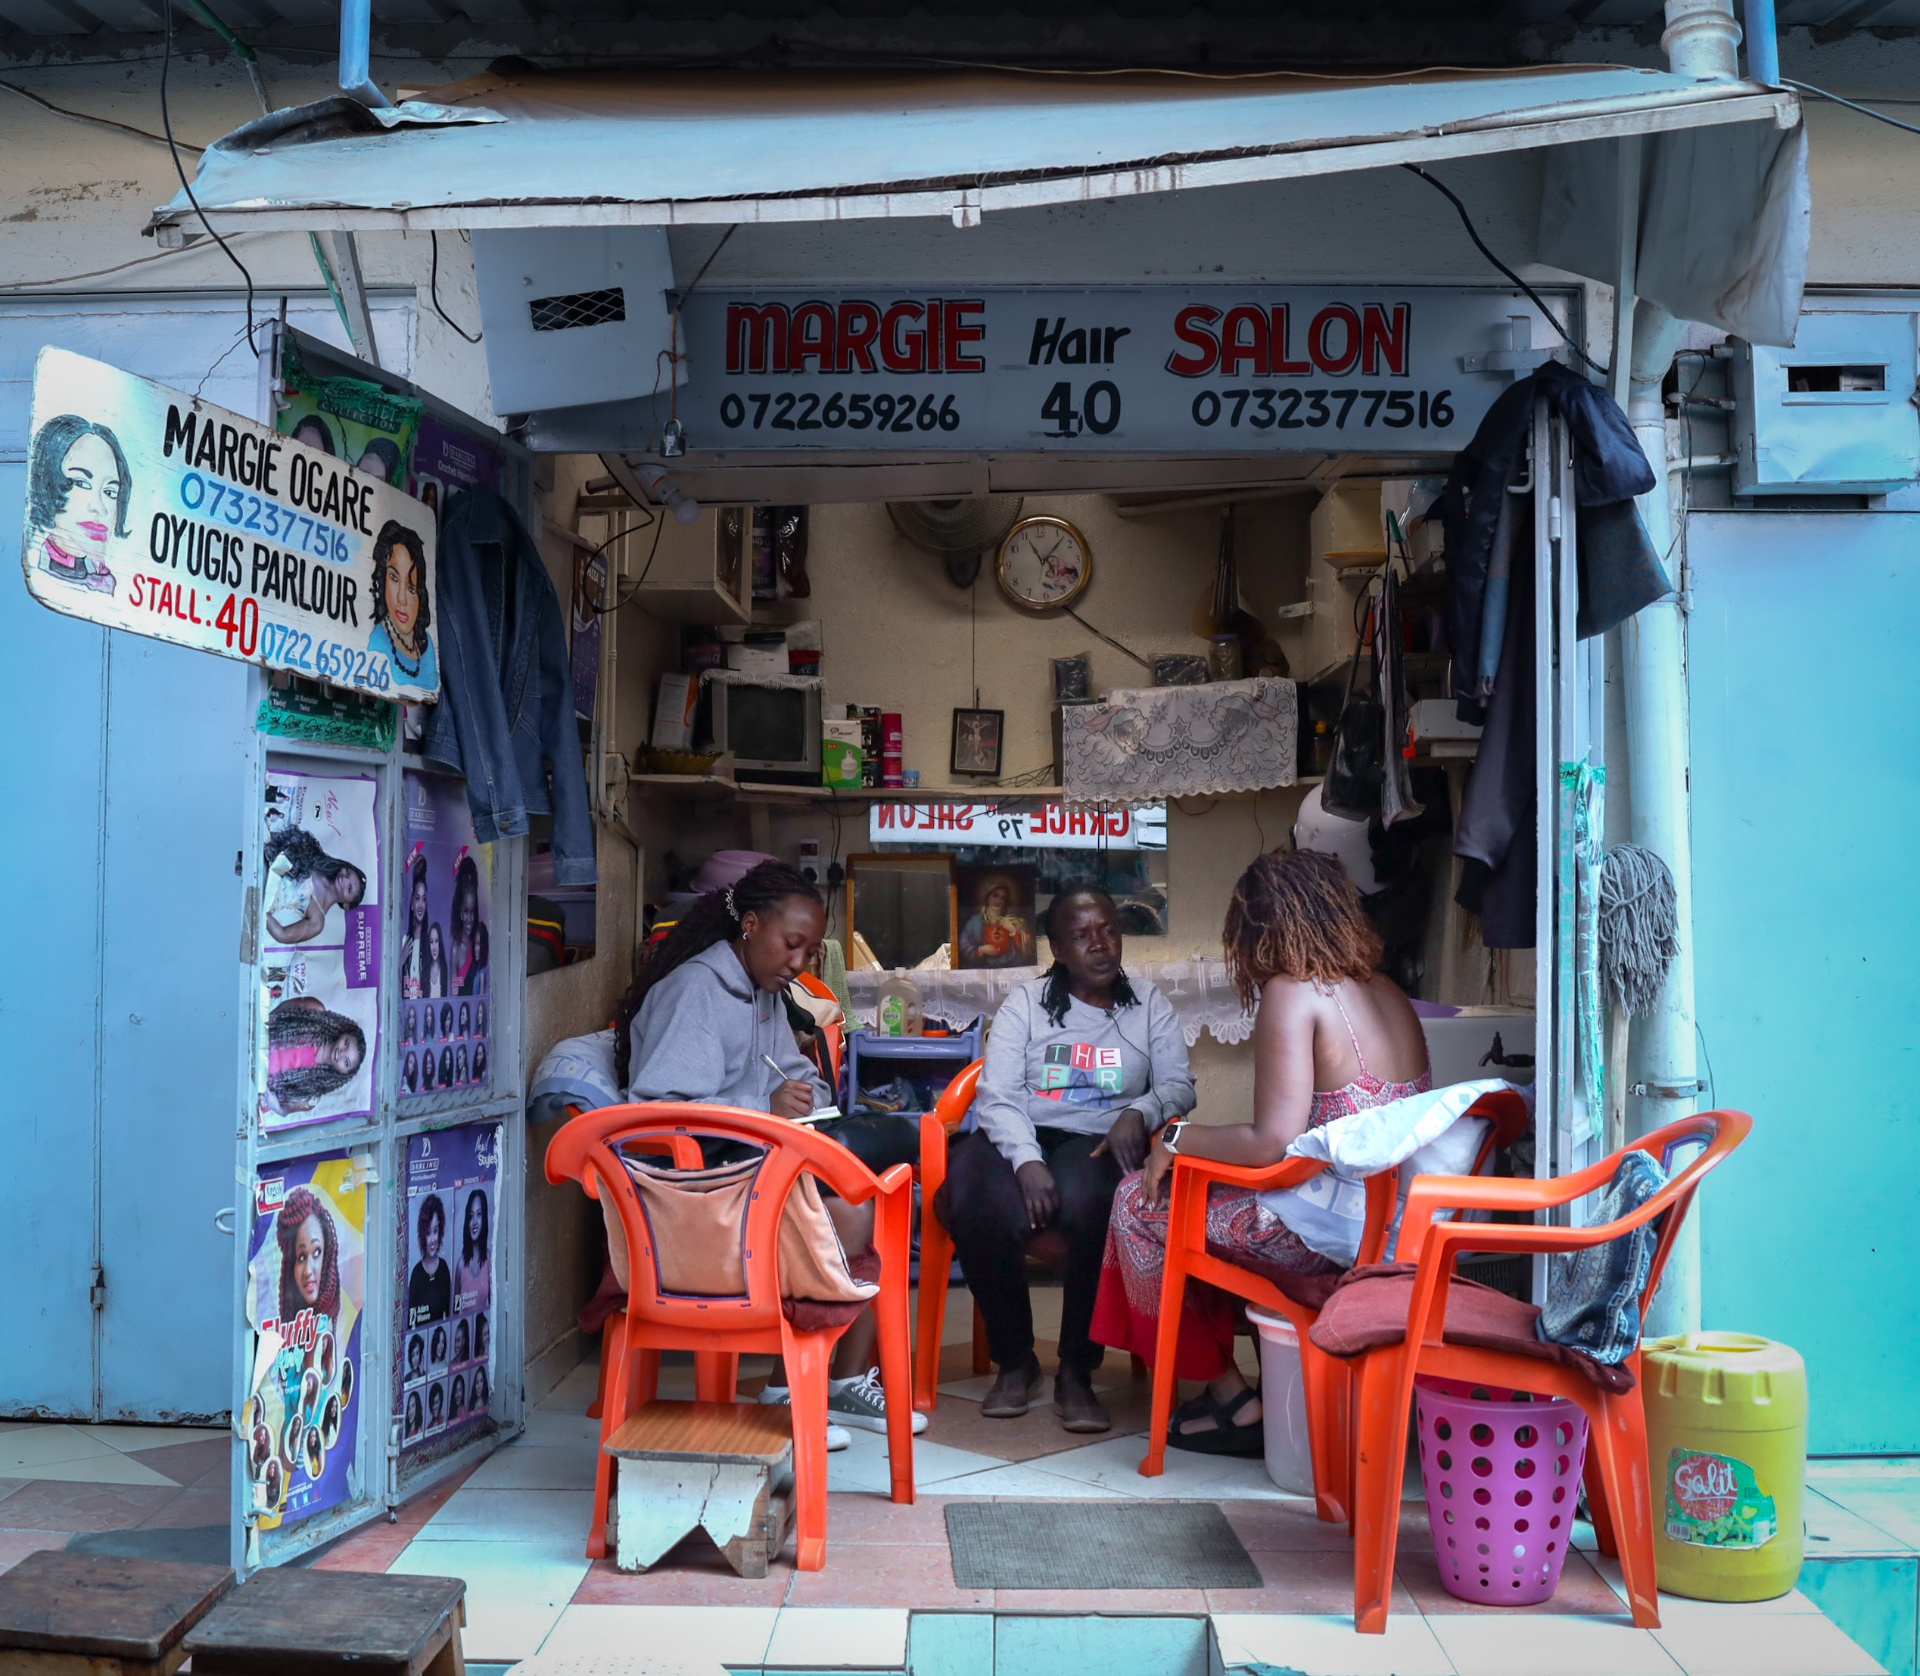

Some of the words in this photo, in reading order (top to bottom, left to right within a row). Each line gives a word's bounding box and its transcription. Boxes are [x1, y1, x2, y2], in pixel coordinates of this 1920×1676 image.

[726, 298, 986, 375] MARGIE
[1028, 317, 1131, 365] Hair
[1164, 302, 1411, 378] SALON
[321, 401, 396, 431] COLLECTION
[720, 391, 960, 433] 0722659266
[1040, 380, 1121, 435] 40
[1192, 388, 1455, 430] 0732377516
[163, 404, 282, 496] MARGIE
[290, 453, 375, 537] OGARE
[180, 472, 349, 563] 0732377516
[1022, 531, 1028, 541] 11
[1036, 525, 1045, 535] 12
[1067, 539, 1073, 549] 2
[150, 512, 244, 589] OYUGIS
[251, 542, 358, 628] PARLOUR
[1006, 561, 1012, 570] 9
[1013, 577, 1019, 587] 8
[1026, 588, 1032, 597] 7
[1043, 591, 1049, 600] 6
[358, 910, 367, 982] SUPREME
[1050, 1044, 1116, 1068] THE
[411, 1160, 438, 1172] DARLING
